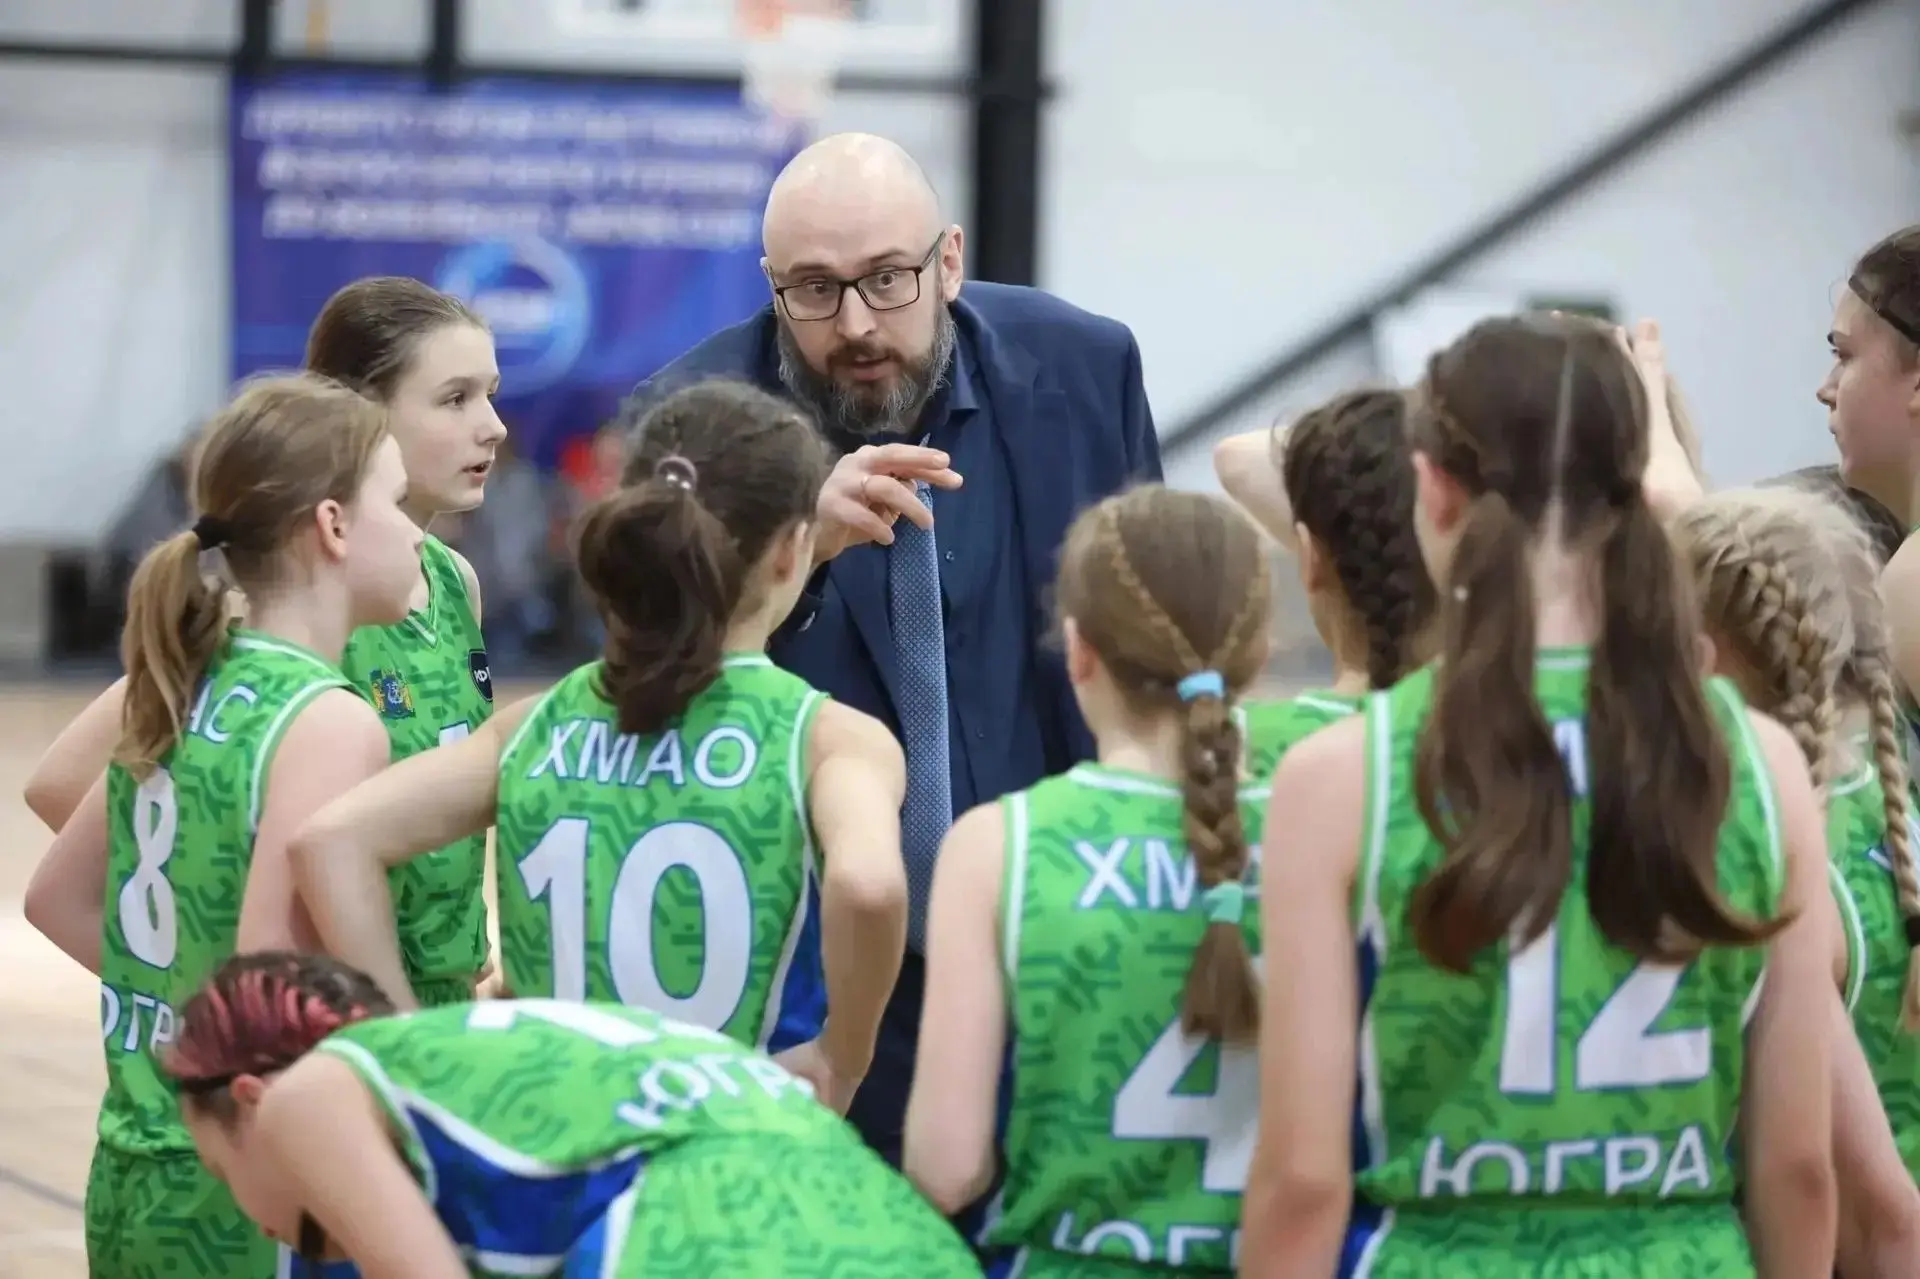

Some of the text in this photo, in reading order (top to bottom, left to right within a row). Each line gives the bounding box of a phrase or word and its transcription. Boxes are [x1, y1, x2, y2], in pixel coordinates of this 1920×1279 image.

[528, 717, 758, 789] ХМАО
[119, 767, 178, 970] 8
[1073, 836, 1264, 911] ХМ
[517, 816, 754, 1036] 10
[101, 982, 186, 1056] ГР
[616, 1053, 815, 1129] ЮГР
[1112, 955, 1264, 1191] 4
[1419, 1123, 1712, 1199] ЮГРА
